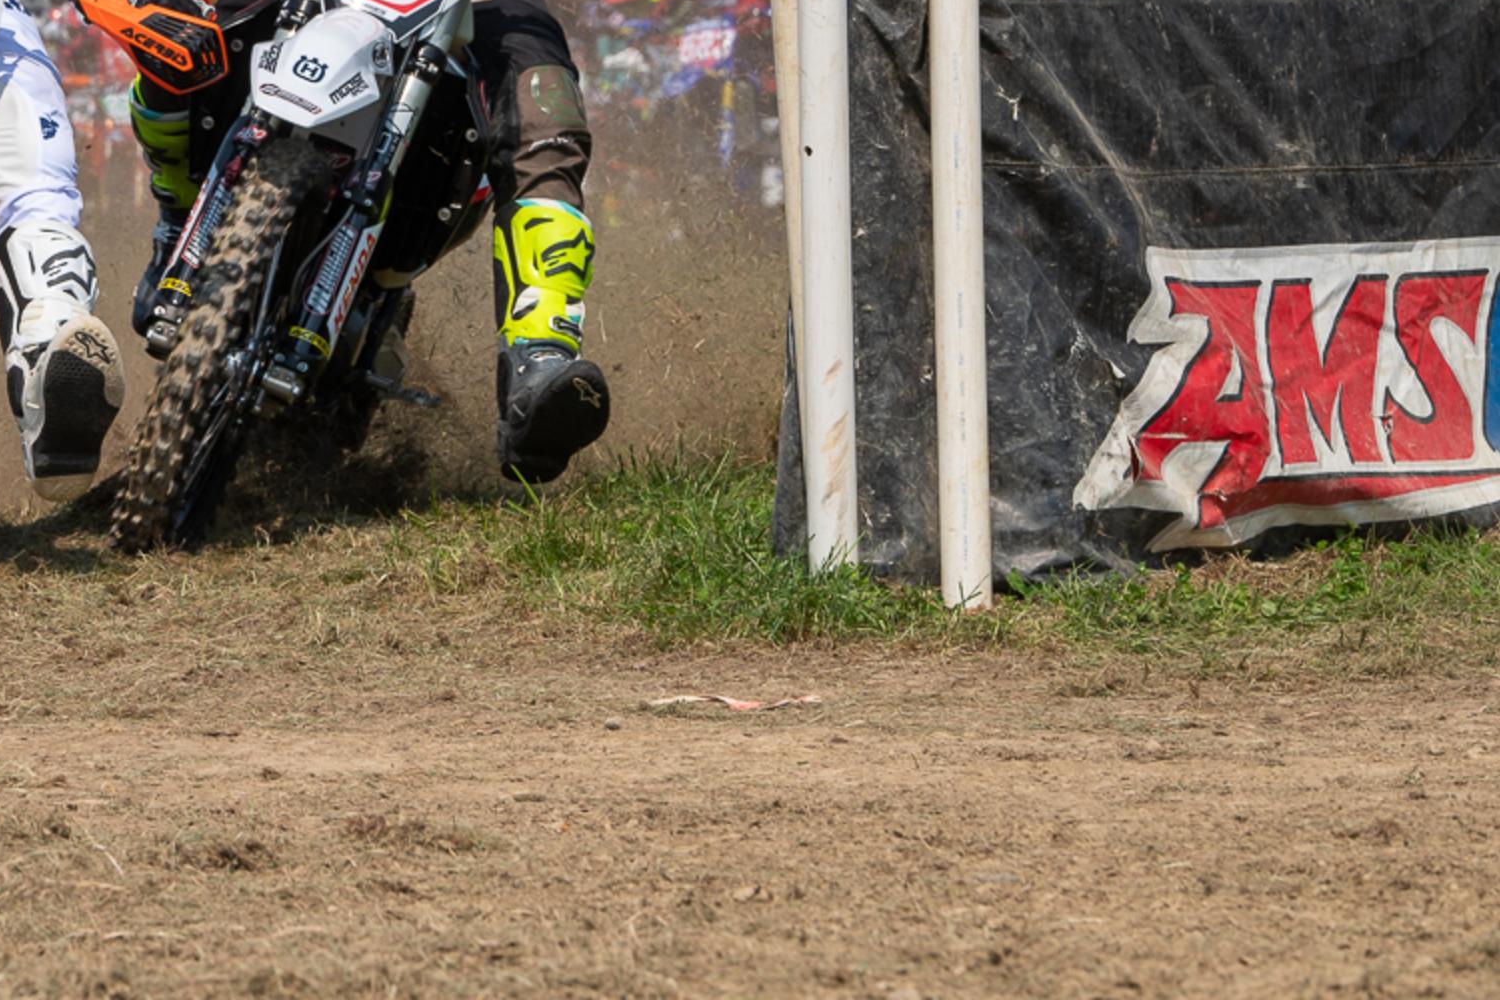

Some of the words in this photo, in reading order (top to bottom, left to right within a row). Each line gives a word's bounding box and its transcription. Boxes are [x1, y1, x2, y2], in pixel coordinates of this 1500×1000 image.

[120, 26, 188, 67] ACERBIS
[334, 231, 377, 336] KENDA
[1137, 268, 1500, 500] AMS
